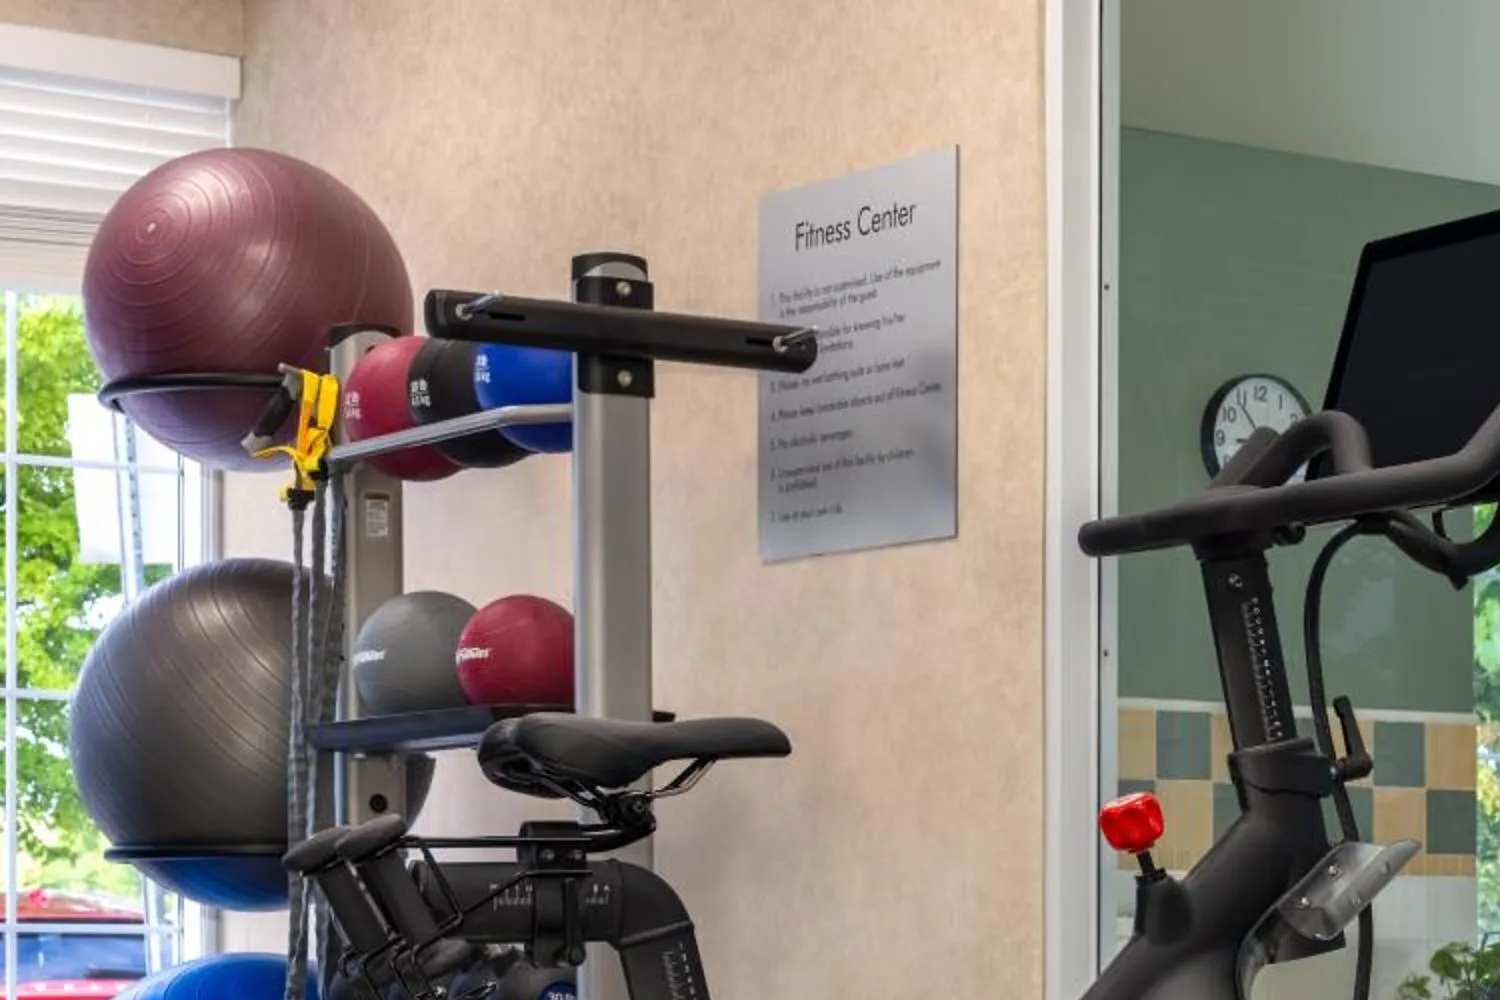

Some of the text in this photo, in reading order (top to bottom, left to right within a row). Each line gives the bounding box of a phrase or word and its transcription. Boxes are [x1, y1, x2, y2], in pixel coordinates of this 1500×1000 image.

[795, 200, 917, 252] Fitness Center
[1253, 385, 1268, 403] 12
[1222, 405, 1237, 423] 10
